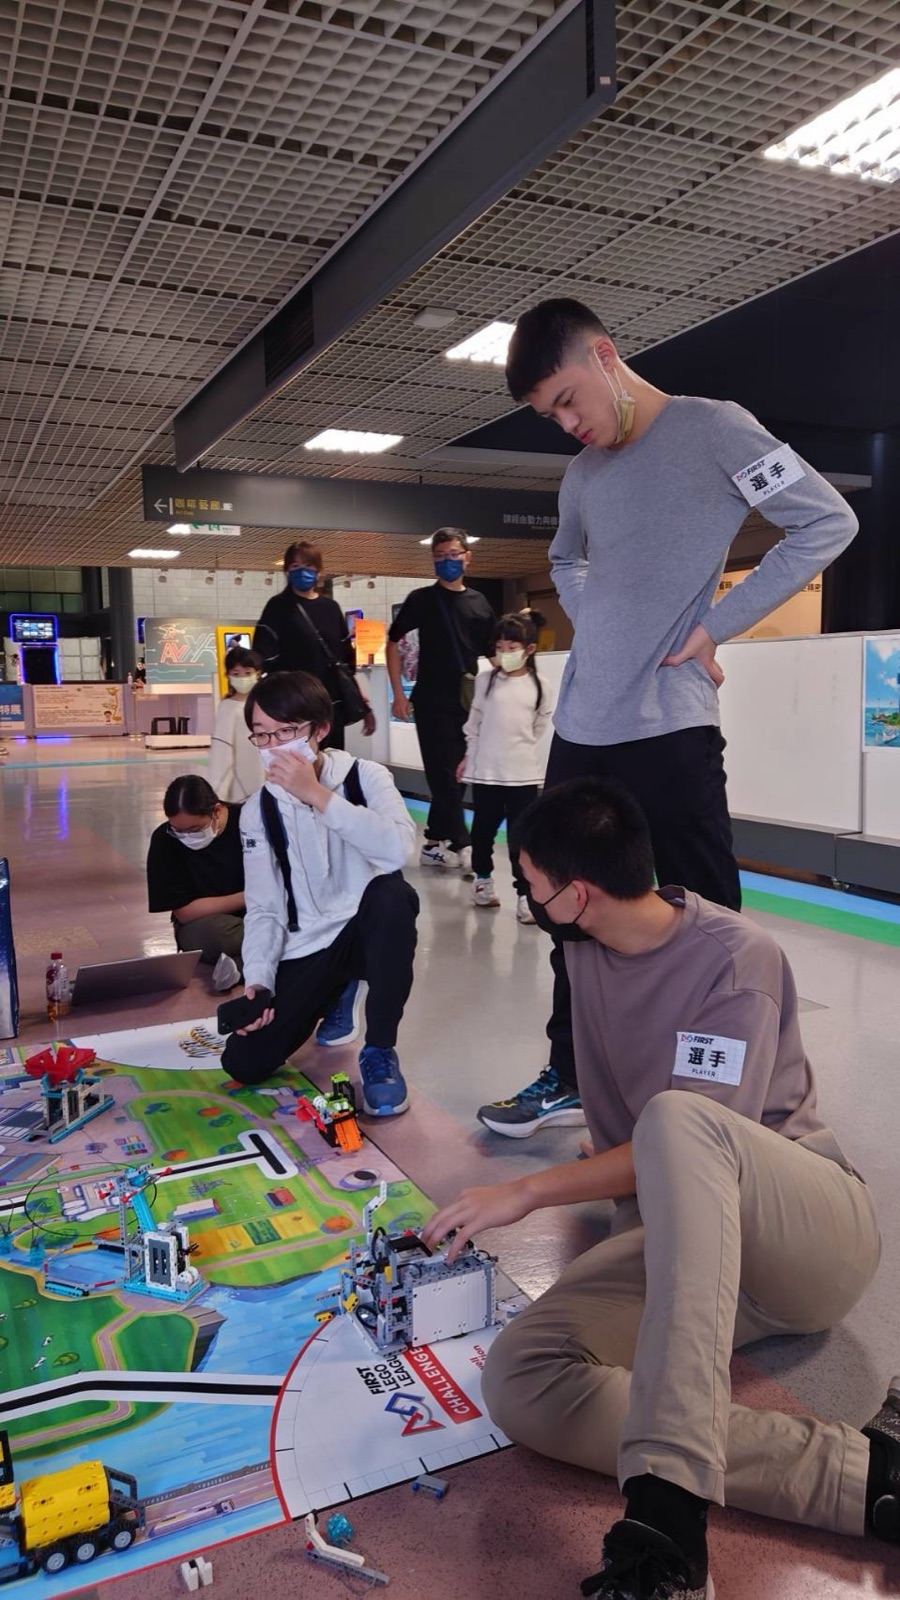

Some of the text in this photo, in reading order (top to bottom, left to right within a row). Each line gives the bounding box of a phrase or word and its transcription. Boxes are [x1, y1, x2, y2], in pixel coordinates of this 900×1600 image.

[746, 460, 766, 475] FIRST
[749, 462, 786, 492] 選手
[763, 480, 785, 496] PLAYER
[693, 1035, 714, 1045] FIRST
[688, 1046, 726, 1068] 選手
[691, 1068, 716, 1077] PLAYER
[356, 1366, 386, 1395] FIRST
[373, 1363, 401, 1392] LEGO
